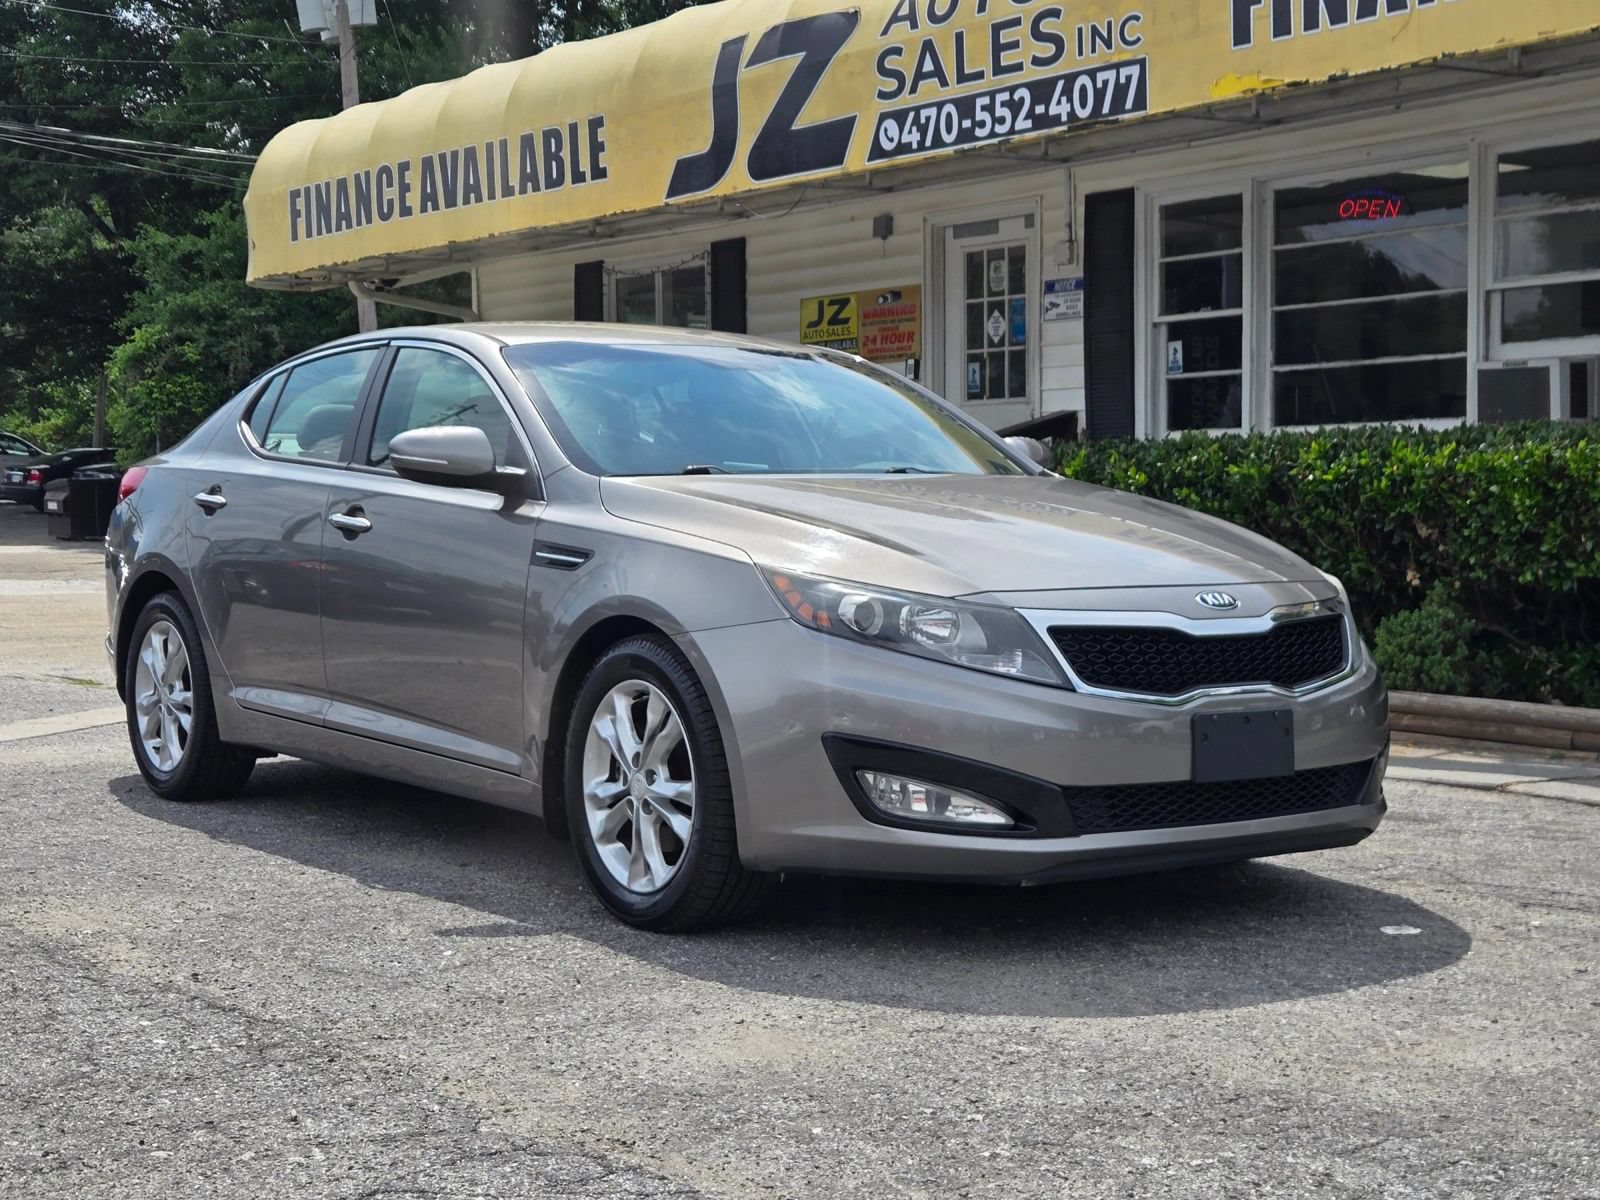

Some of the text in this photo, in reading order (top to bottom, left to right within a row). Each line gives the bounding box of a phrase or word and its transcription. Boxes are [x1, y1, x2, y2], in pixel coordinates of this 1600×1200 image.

[875, 7, 1144, 101] SALES INC
[665, 9, 859, 200] JZ
[901, 64, 1140, 149] 470-552-4077
[288, 112, 608, 243] FINANCE AVAILABLE
[1339, 199, 1401, 219] OPEN
[806, 296, 852, 329] JZ
[803, 329, 825, 340] AUTO
[862, 331, 916, 347] 24 HOUR
[1202, 592, 1235, 605] KIA
